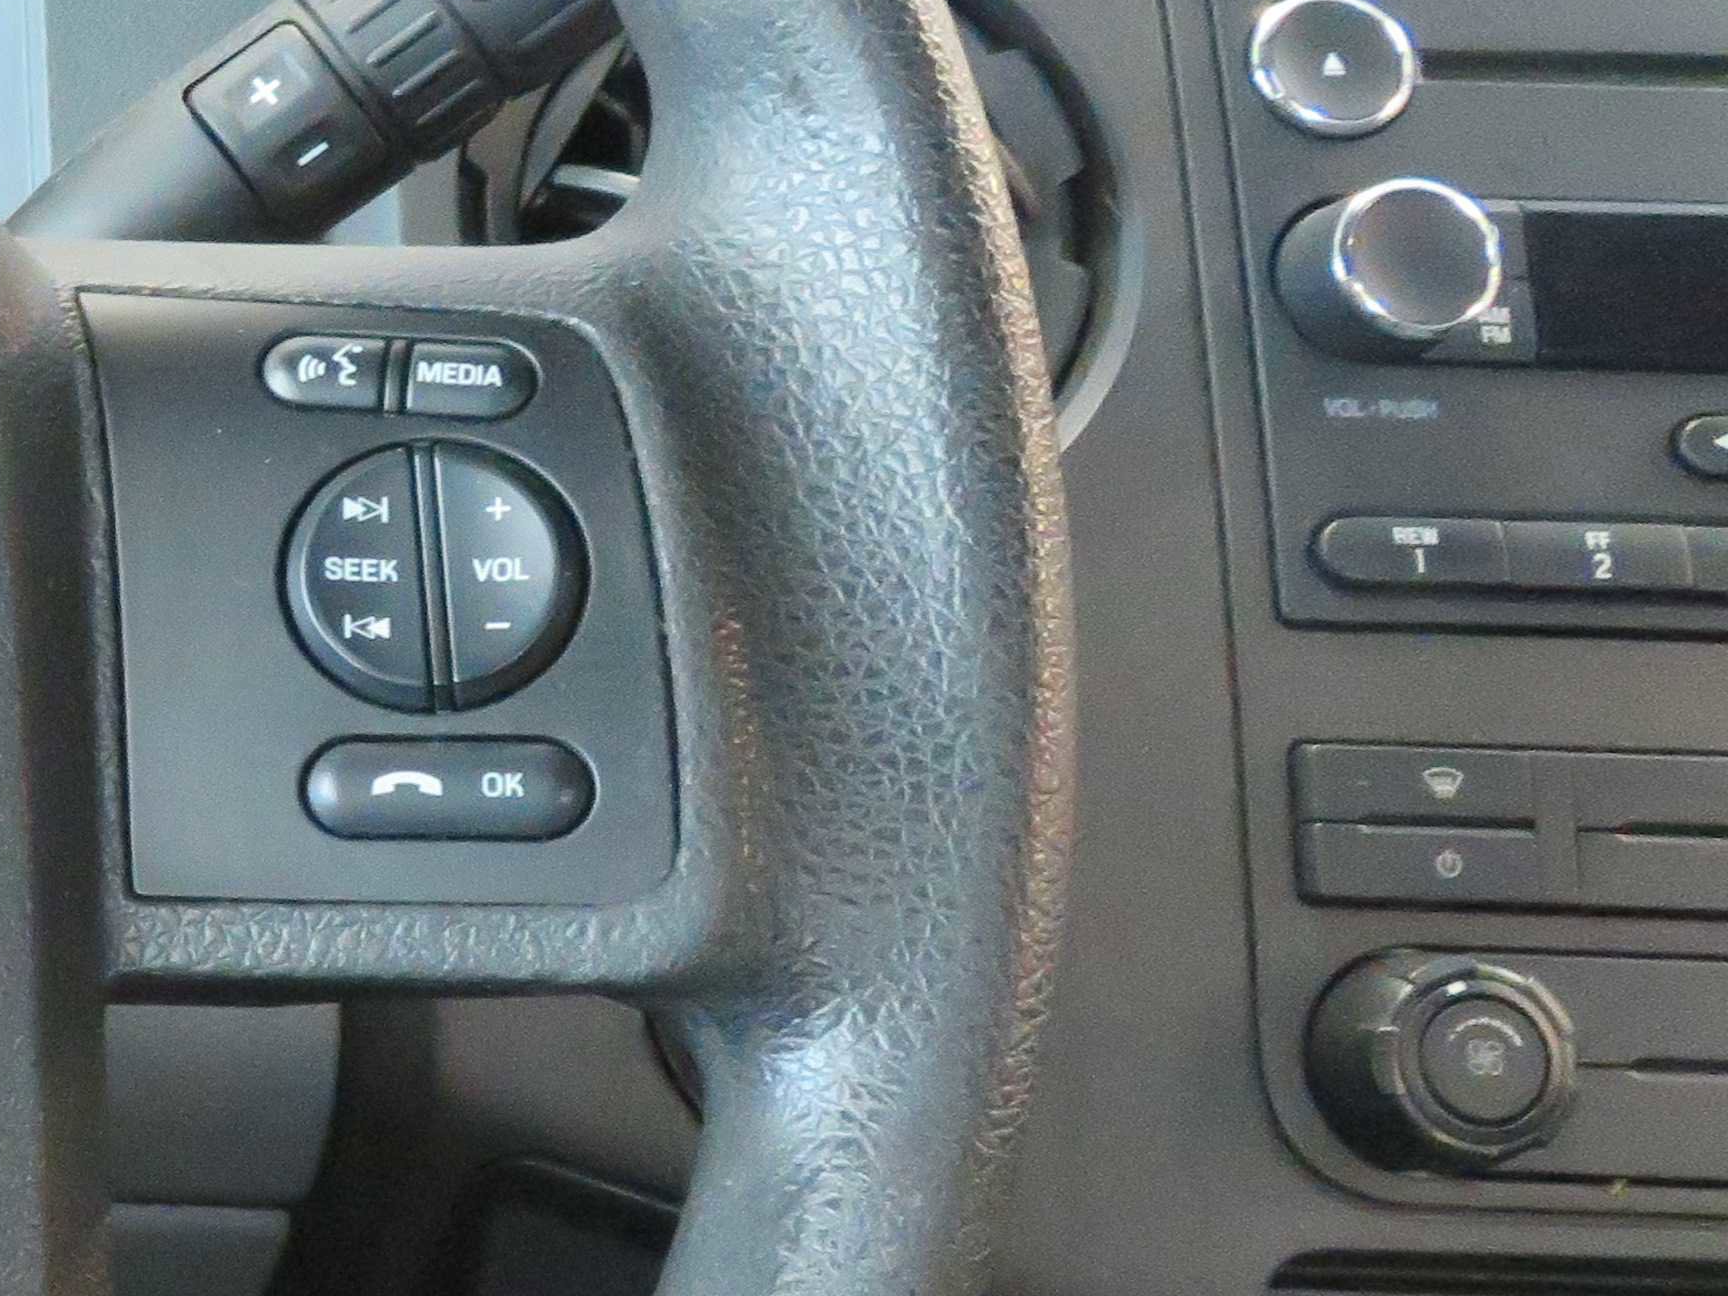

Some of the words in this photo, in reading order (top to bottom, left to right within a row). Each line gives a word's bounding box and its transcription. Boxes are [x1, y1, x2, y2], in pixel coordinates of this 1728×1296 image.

[1480, 324, 1512, 343] FM
[416, 360, 503, 387] MEDIA
[1584, 530, 1612, 550] FF
[324, 556, 399, 583] SEEK
[472, 558, 529, 583] VOL
[1414, 547, 1426, 574] 1
[1592, 552, 1614, 580] 2
[481, 772, 525, 799] OK
